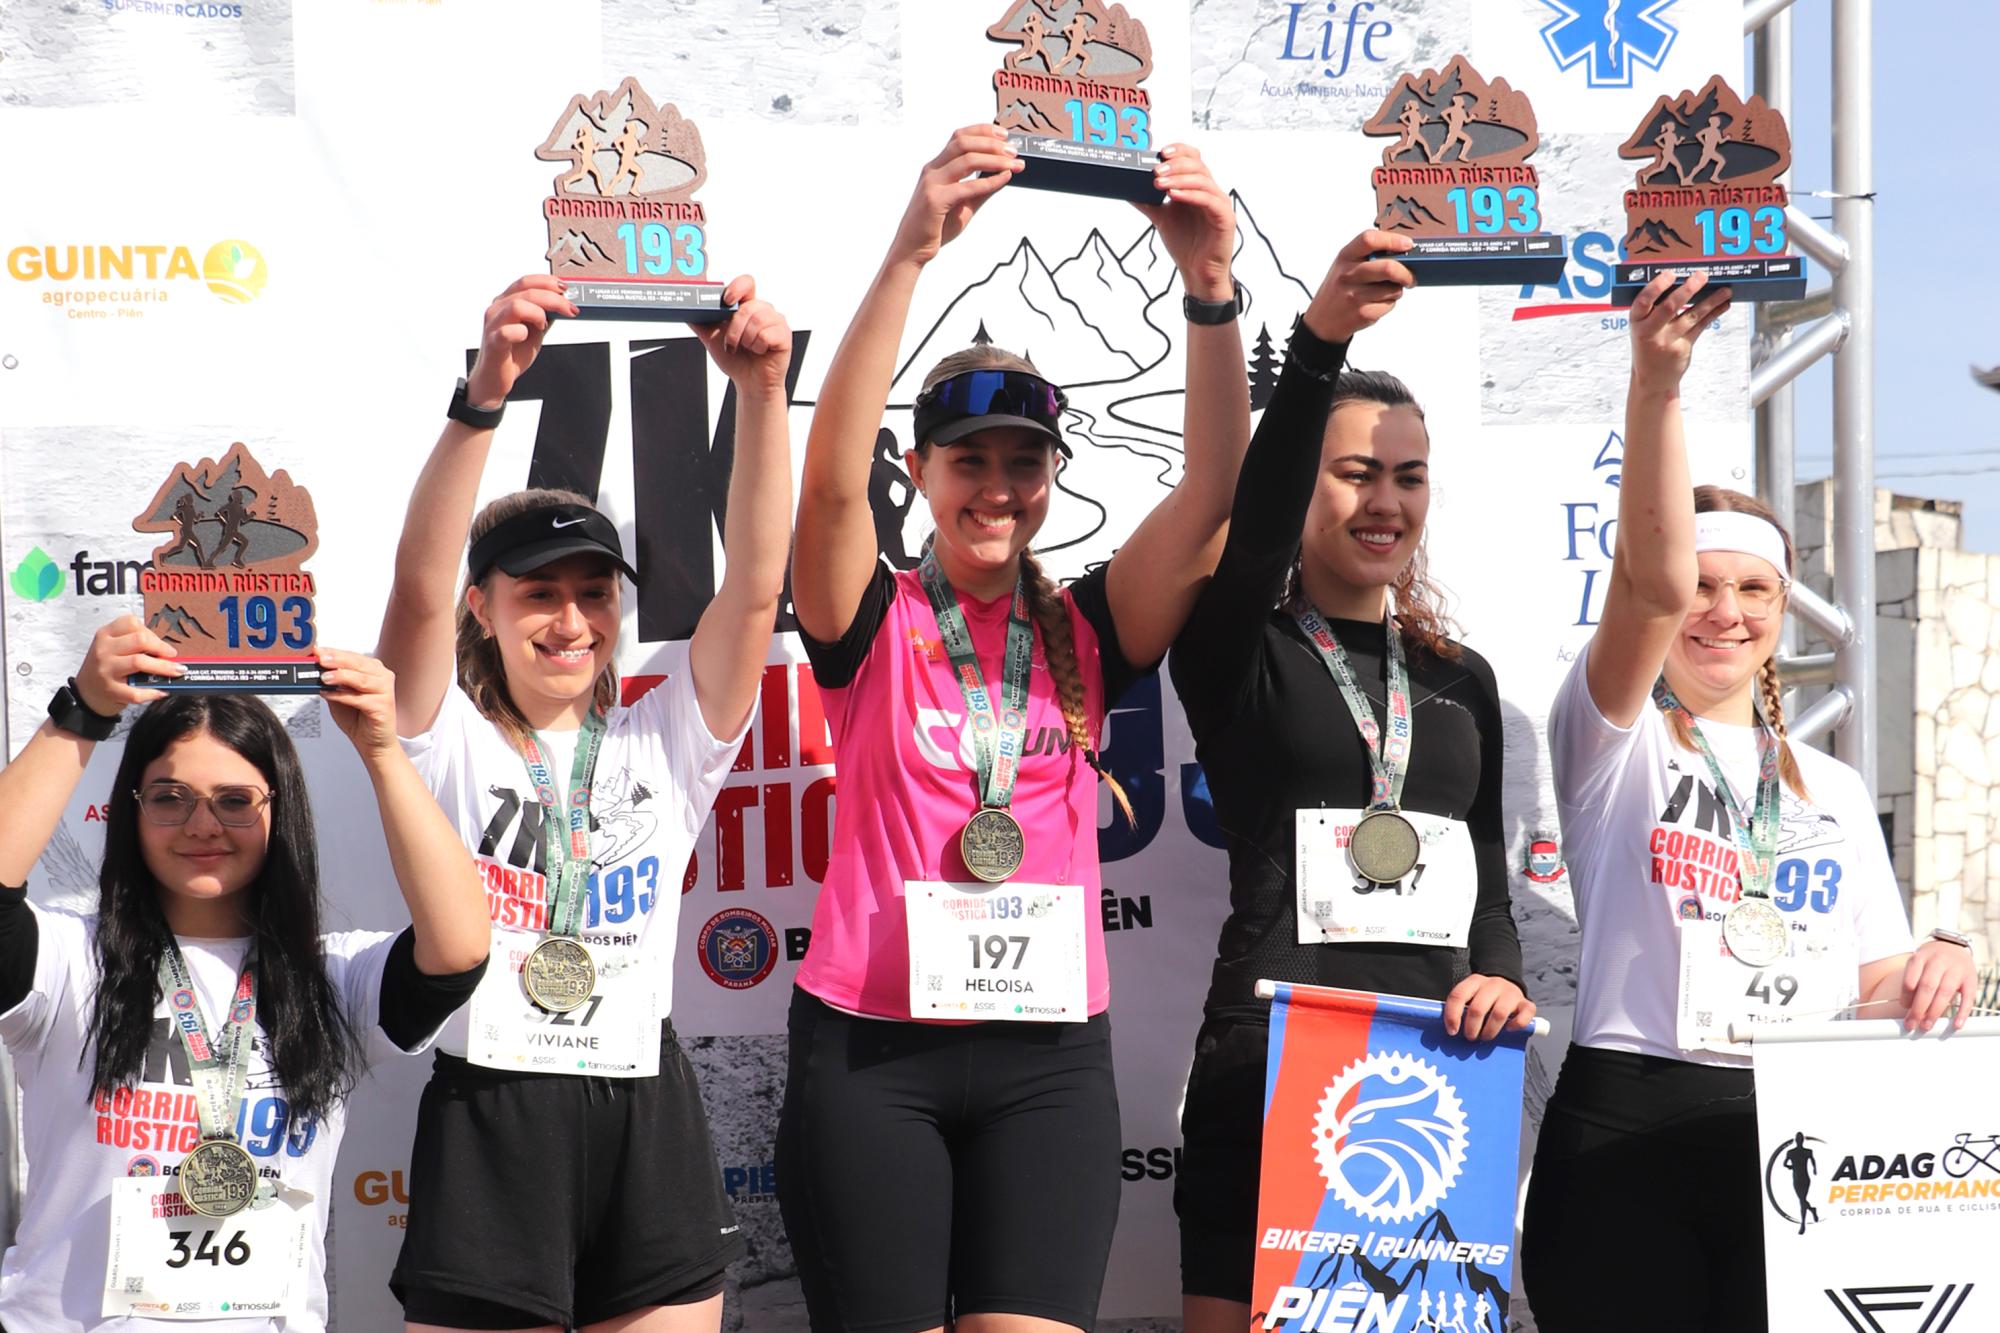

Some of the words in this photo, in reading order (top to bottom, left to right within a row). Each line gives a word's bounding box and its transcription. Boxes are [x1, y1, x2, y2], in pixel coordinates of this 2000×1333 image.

[105, 0, 242, 18] SUPERMERCADOS
[1276, 2, 1392, 78] Life
[997, 70, 1074, 97] CORRIDA
[1296, 81, 1351, 98] MINERAL
[1355, 84, 1394, 97] NATU
[1064, 99, 1150, 150] 193
[1375, 168, 1456, 185] CORRIDA
[1459, 163, 1537, 184] RÚSTICA
[549, 198, 626, 219] CORRIDA
[1625, 189, 1705, 209] CORRIDA
[1709, 184, 1788, 207] RÚSTICA
[1447, 185, 1540, 234] 193
[1695, 205, 1786, 256] 193
[616, 220, 705, 276] 193
[7, 246, 200, 282] GUINTA
[42, 287, 168, 306] agropecuária
[67, 308, 107, 319] Centro
[143, 573, 229, 593] CORRIDA
[232, 569, 313, 593] RÚSTICA
[219, 595, 313, 649] 193
[1301, 614, 1321, 635] 193
[969, 688, 989, 712] 193
[1394, 717, 1408, 738] 193
[1000, 731, 1015, 758] 193
[531, 764, 551, 785] 193
[571, 808, 583, 832] 193
[585, 855, 660, 929] 193
[1774, 858, 1843, 914] 93
[987, 896, 1023, 920] 193
[700, 925, 712, 950] CORPO
[710, 917, 720, 926] DE
[720, 910, 761, 923] BOMBEIROS
[761, 920, 777, 948] MILITAR
[1417, 929, 1447, 940] famossu
[968, 934, 1031, 970] 197
[965, 978, 1034, 994] HELOISA
[1745, 971, 1799, 1006] 49
[1024, 1005, 1062, 1015] famossu
[178, 1011, 199, 1035] 193
[527, 1032, 600, 1051] VIVIANE
[95, 1086, 199, 1122] CORRID
[96, 1113, 200, 1154] RÚSTIC
[258, 1166, 282, 1180] IÊN
[1831, 1152, 1936, 1182] ADAG
[223, 1183, 248, 1200] 193
[1828, 1179, 2000, 1205] PERFORMANC
[1840, 1207, 1892, 1217] CORRIDA
[1898, 1206, 1912, 1215] DE
[1918, 1205, 1941, 1214] RUA
[1947, 1204, 1953, 1213] E
[166, 1230, 251, 1269] 346
[1260, 1227, 1360, 1257] BIKERS
[1373, 1236, 1510, 1265] RUNNERS
[176, 1302, 201, 1311] ASSIS
[1261, 1281, 1410, 1333] PIÊN
